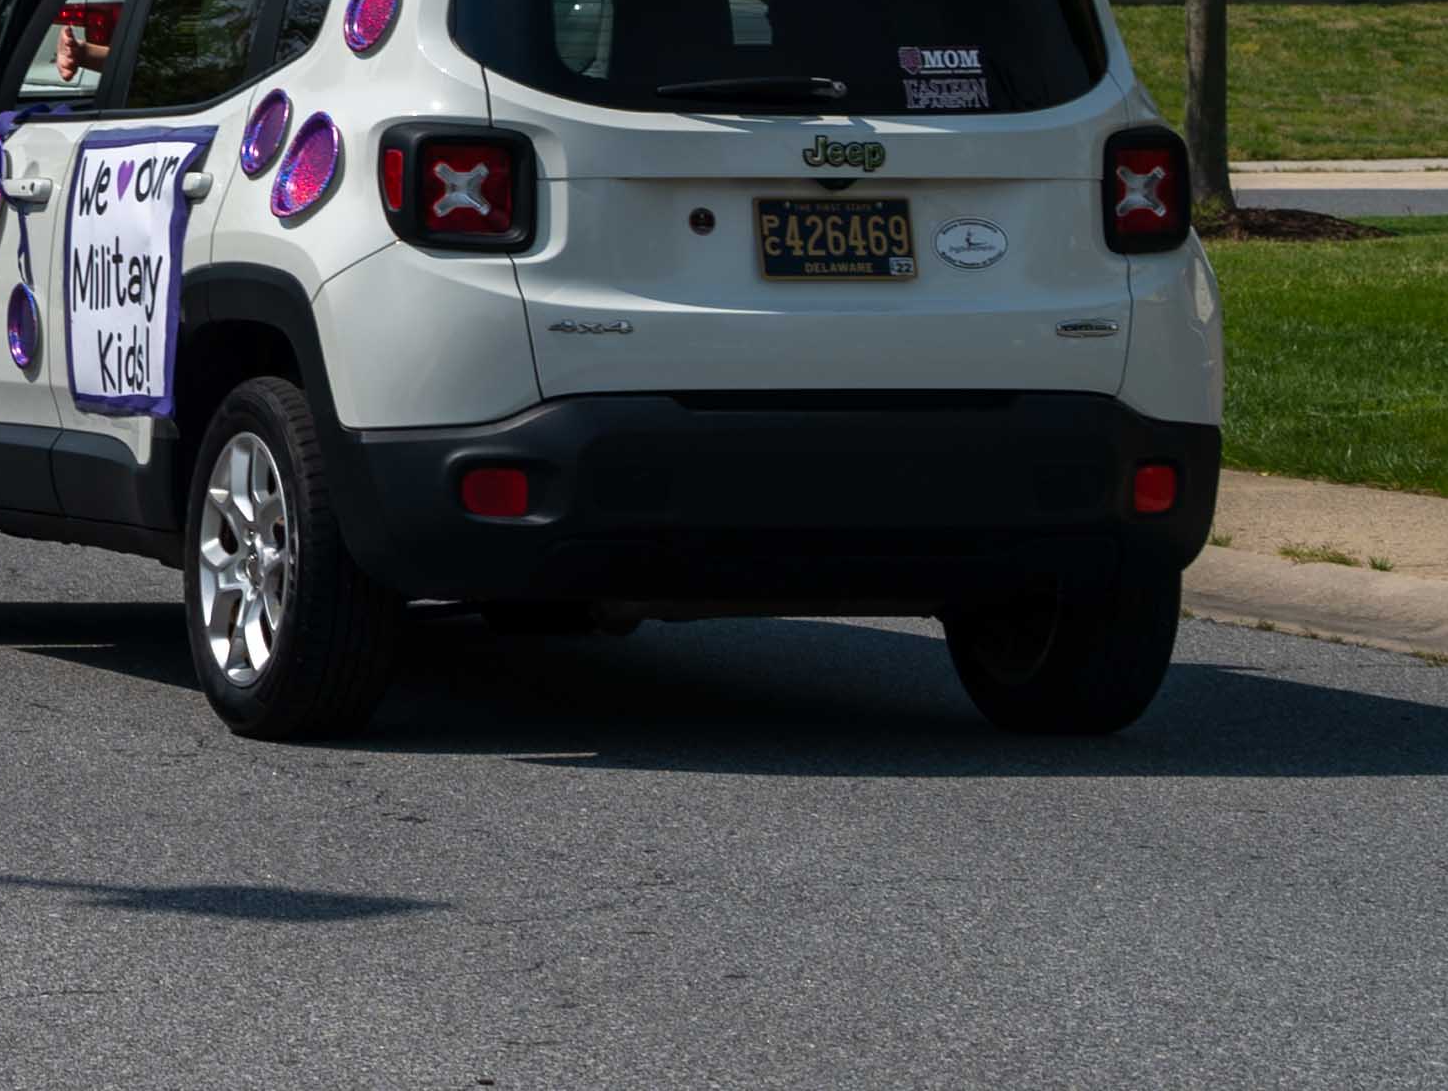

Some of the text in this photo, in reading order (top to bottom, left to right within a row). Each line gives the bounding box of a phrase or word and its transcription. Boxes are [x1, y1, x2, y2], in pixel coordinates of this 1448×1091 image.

[920, 49, 982, 68] MOM
[803, 135, 886, 172] Jeep
[78, 155, 179, 217] We our
[785, 214, 910, 257] 426469
[804, 262, 874, 274] DELAWARE
[546, 319, 634, 334] 4x4
[98, 324, 151, 396] Kids!
